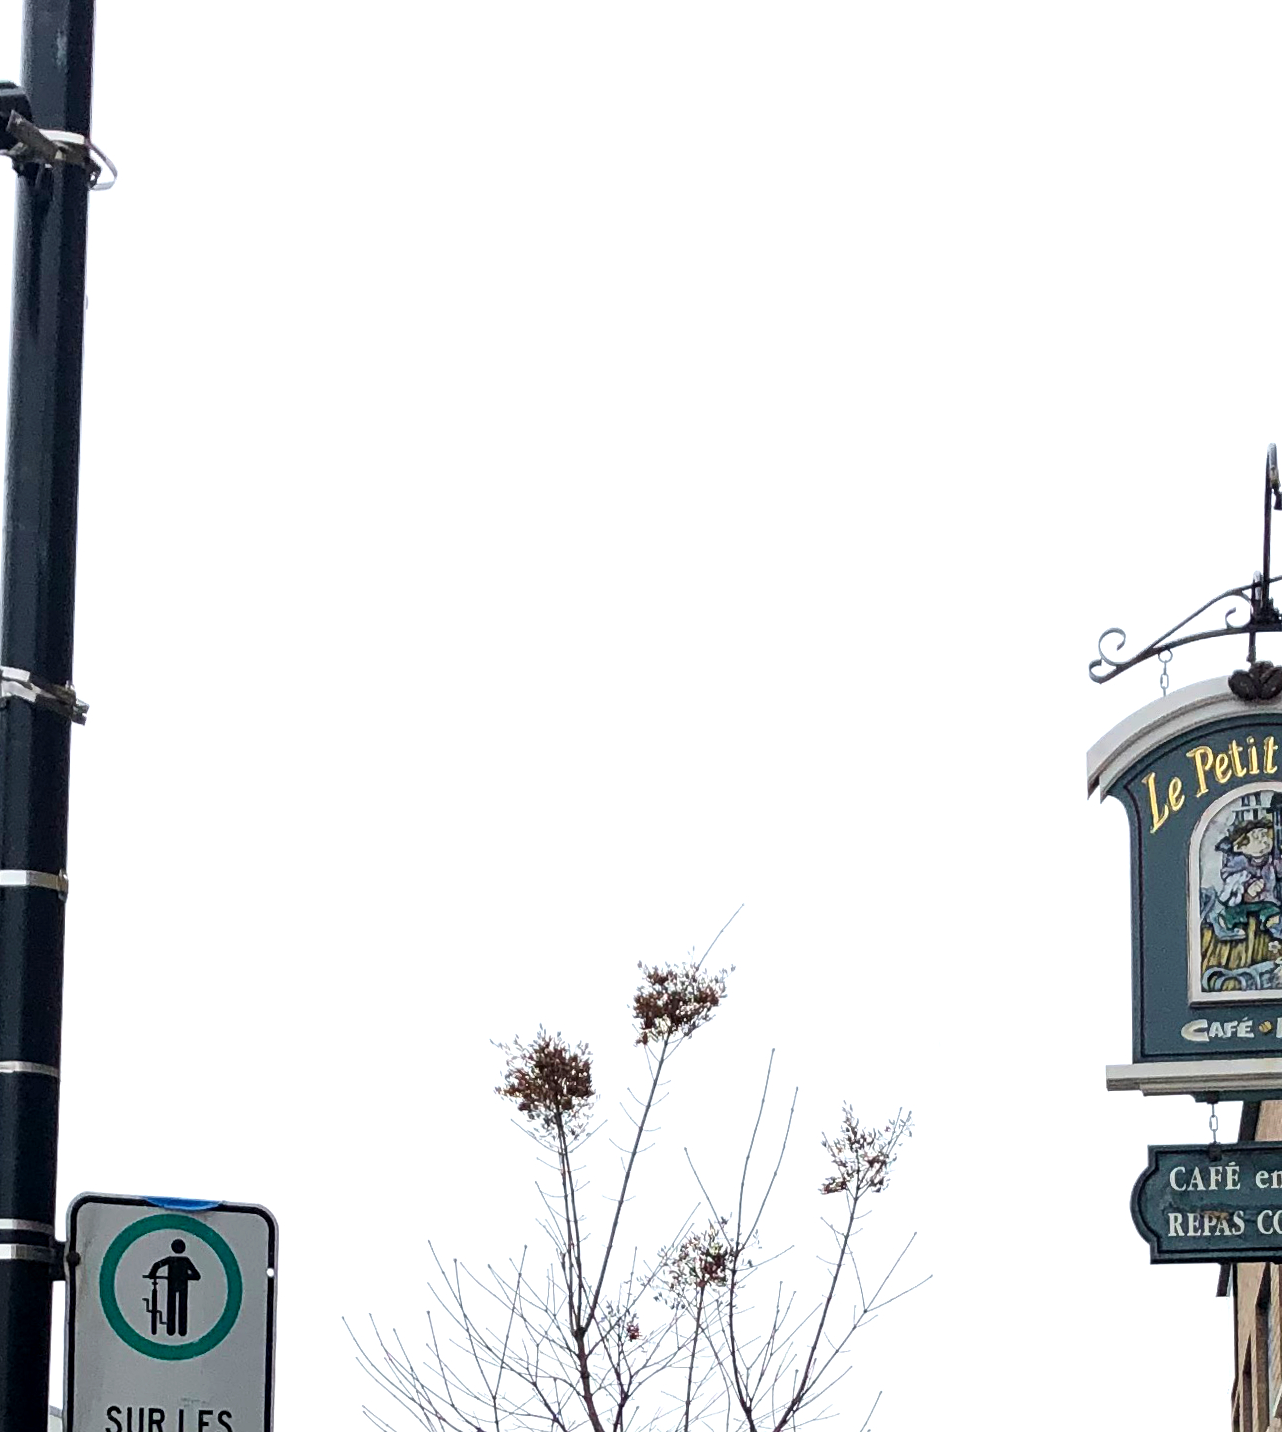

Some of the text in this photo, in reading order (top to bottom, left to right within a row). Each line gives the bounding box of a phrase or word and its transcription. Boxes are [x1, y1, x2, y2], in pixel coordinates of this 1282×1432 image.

[1142, 771, 1185, 835] Le
[1186, 735, 1278, 798] Petit
[1181, 1016, 1254, 1043] CAFÉ
[1169, 1161, 1240, 1191] CAFÉ
[1167, 1211, 1245, 1237] REPAS
